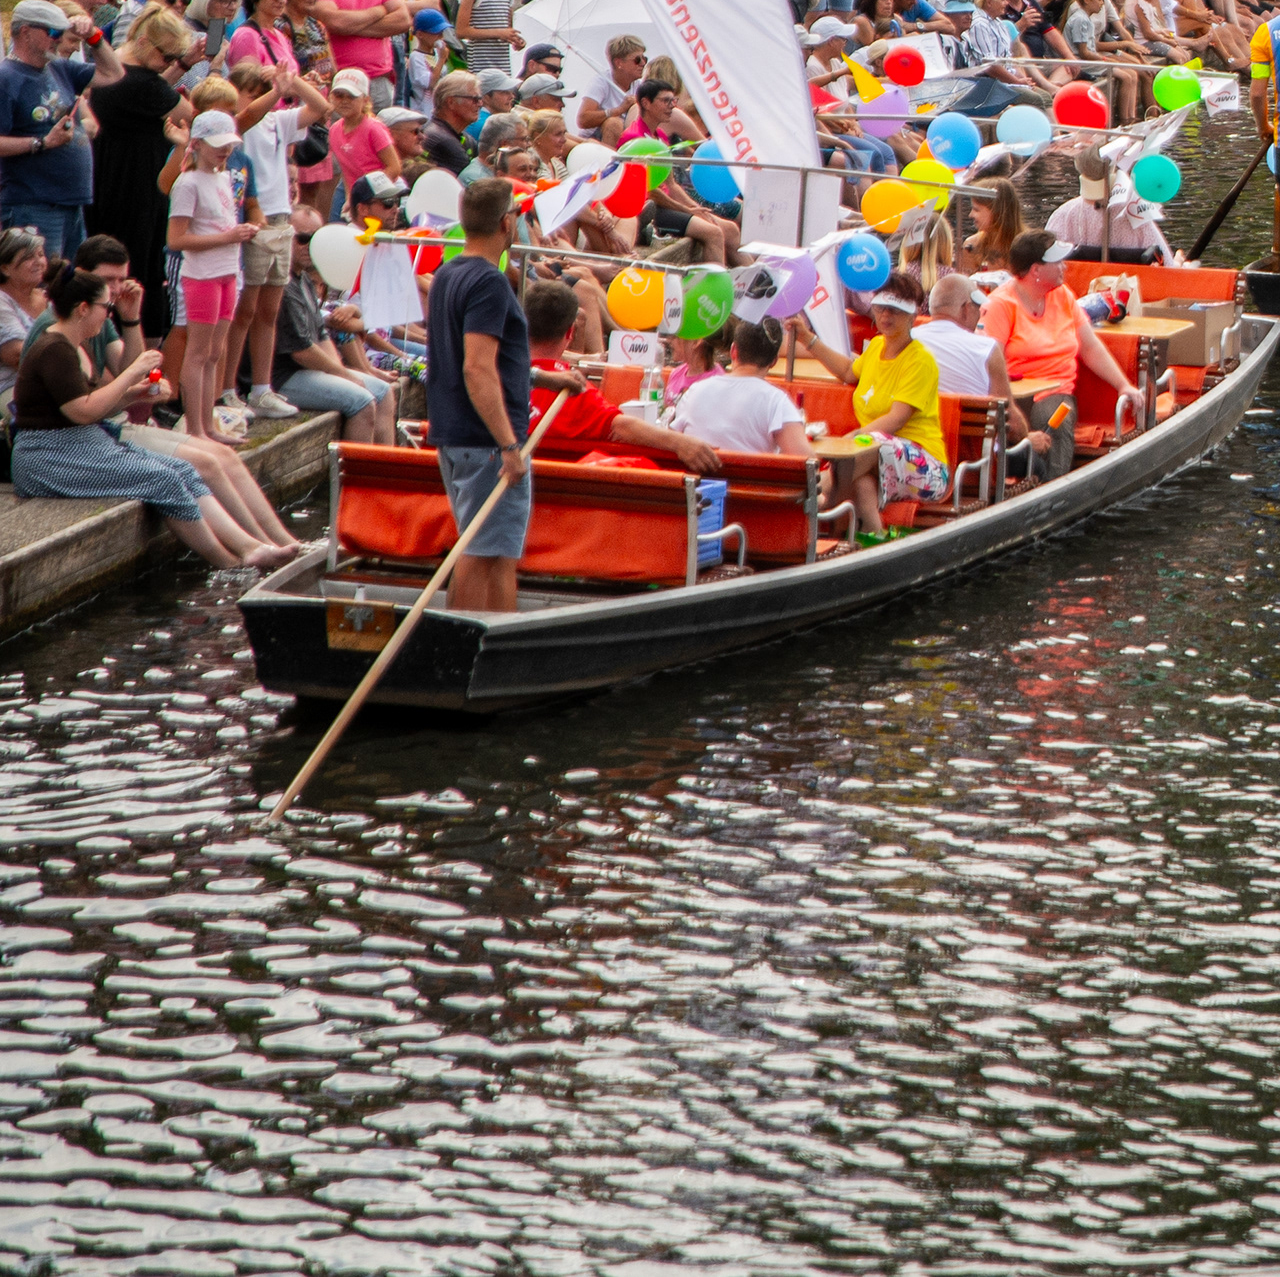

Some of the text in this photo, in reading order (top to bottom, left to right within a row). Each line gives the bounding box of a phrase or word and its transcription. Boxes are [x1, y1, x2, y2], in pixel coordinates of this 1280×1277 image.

[1215, 93, 1237, 104] AWO
[1136, 203, 1155, 214] AWO
[668, 305, 681, 319] AWO
[628, 342, 649, 354] AWO
